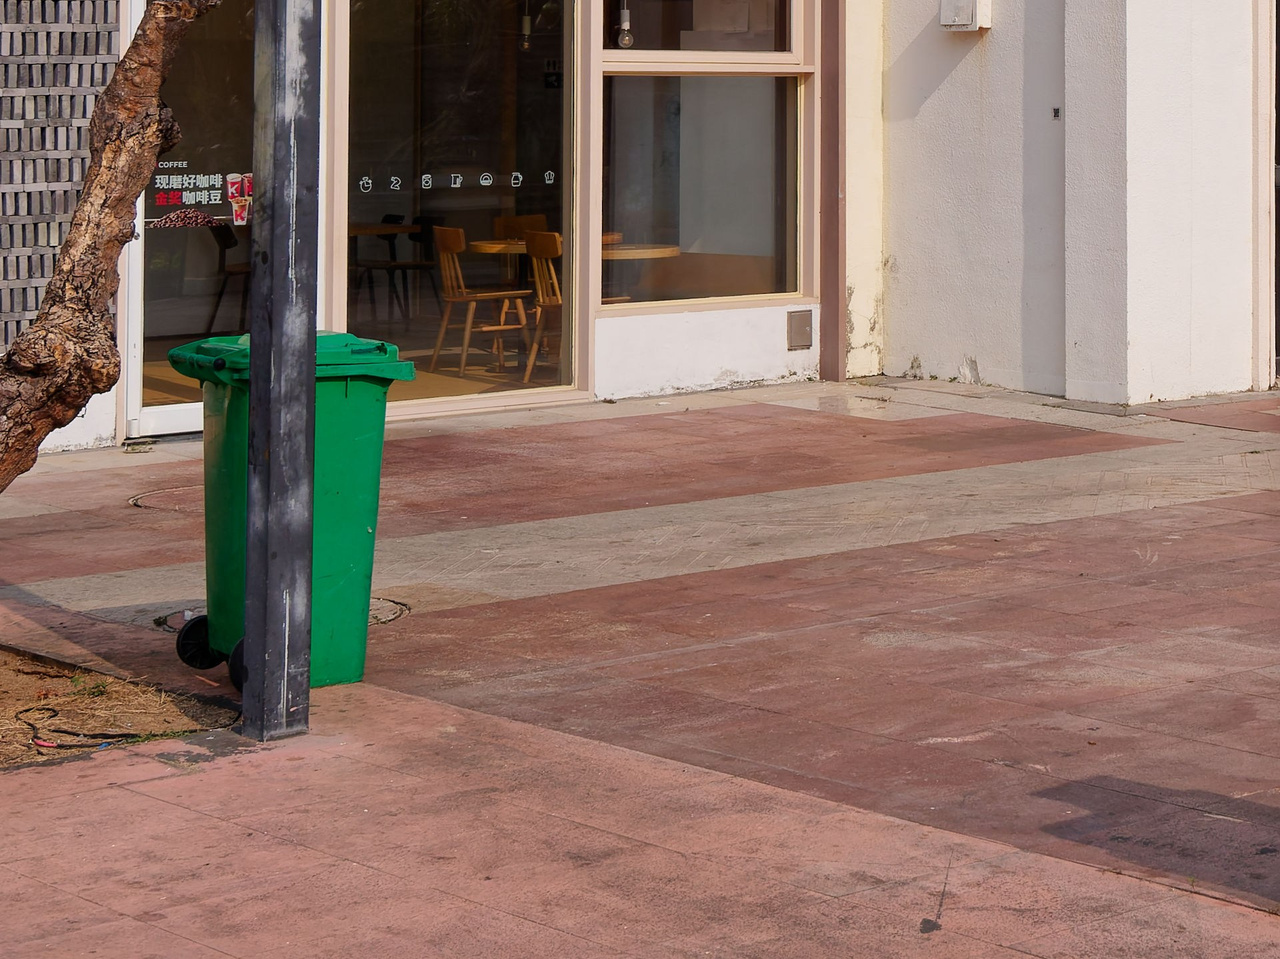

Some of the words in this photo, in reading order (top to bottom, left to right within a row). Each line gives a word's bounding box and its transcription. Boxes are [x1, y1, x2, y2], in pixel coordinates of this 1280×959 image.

[154, 173, 223, 189] 现磨好咖啡
[154, 190, 222, 206] 金奖咖啡豆
[228, 183, 239, 197] K
